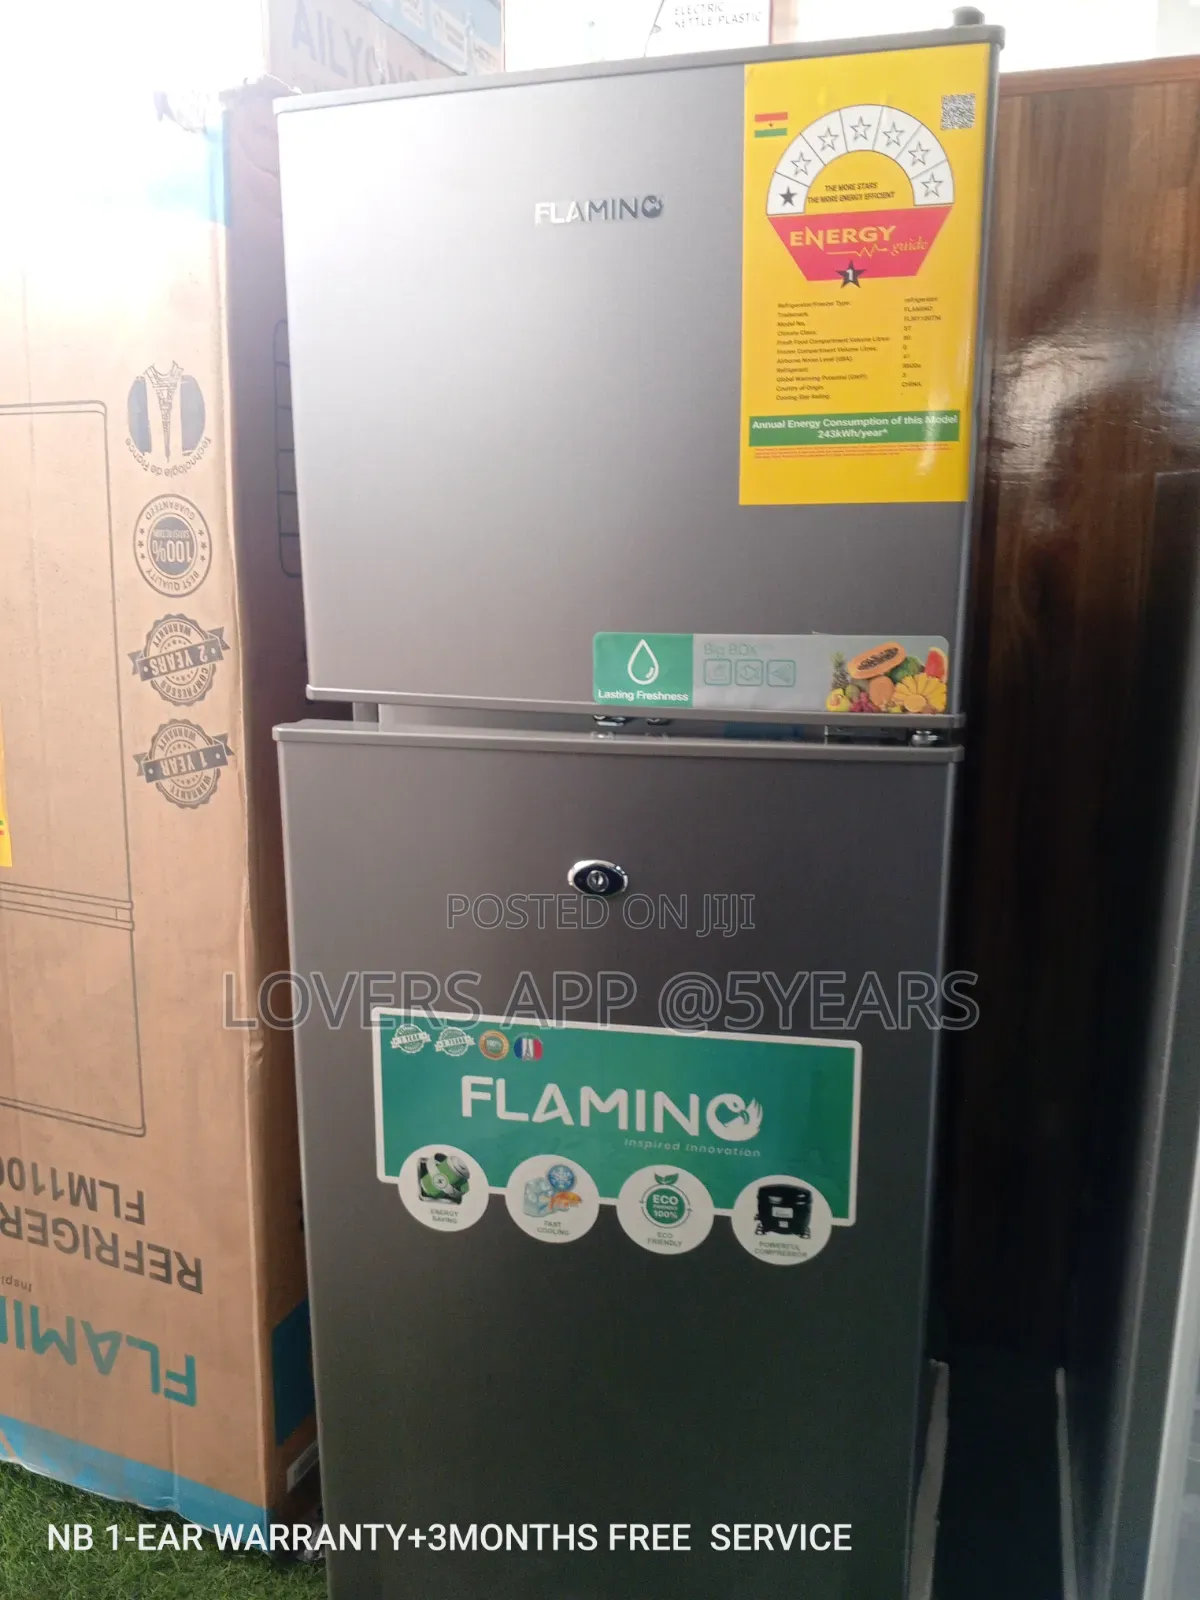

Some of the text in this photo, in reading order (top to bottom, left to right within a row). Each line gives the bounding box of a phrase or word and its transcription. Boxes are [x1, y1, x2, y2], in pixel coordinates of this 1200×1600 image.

[675, 2, 724, 15] ELECTRIC
[675, 11, 761, 28] KETTLE PLASTIC
[825, 184, 837, 192] THE
[839, 183, 856, 191] MORE
[808, 191, 895, 204] THE MORE ENERGY EFFICIENT
[790, 225, 897, 252] ENERGY
[891, 235, 928, 256] guide
[845, 269, 854, 281] 1
[752, 414, 958, 430] Annual Energy Consumption of this Model
[125, 438, 163, 477] de France
[164, 437, 213, 478] Technologie
[145, 502, 196, 521] GUARANTEED
[152, 540, 192, 563] 100%
[145, 567, 200, 591] BEST QUALITY
[152, 623, 193, 648] WARRANTY
[704, 643, 724, 658] Big
[149, 644, 209, 676] 2 YEARS
[160, 667, 209, 699] COMPRESSOR
[598, 688, 689, 702] Lasting Freshness
[157, 727, 197, 752] WARRANTY
[160, 751, 208, 777] 1 YEAR
[169, 775, 212, 800] WARRANTY
[0, 1156, 146, 1225] FLM110
[652, 1193, 679, 1204] ECO
[430, 1208, 459, 1217] ENERGY
[432, 1216, 458, 1224] SAVING
[653, 1210, 678, 1219] 100%
[537, 1227, 569, 1236] COOLING
[544, 1220, 562, 1228] FAST
[647, 1237, 683, 1247] FRIENDLY
[657, 1231, 673, 1239] ECO
[758, 1241, 801, 1250] POWERFUL
[754, 1249, 808, 1258] COMPRESSOR
